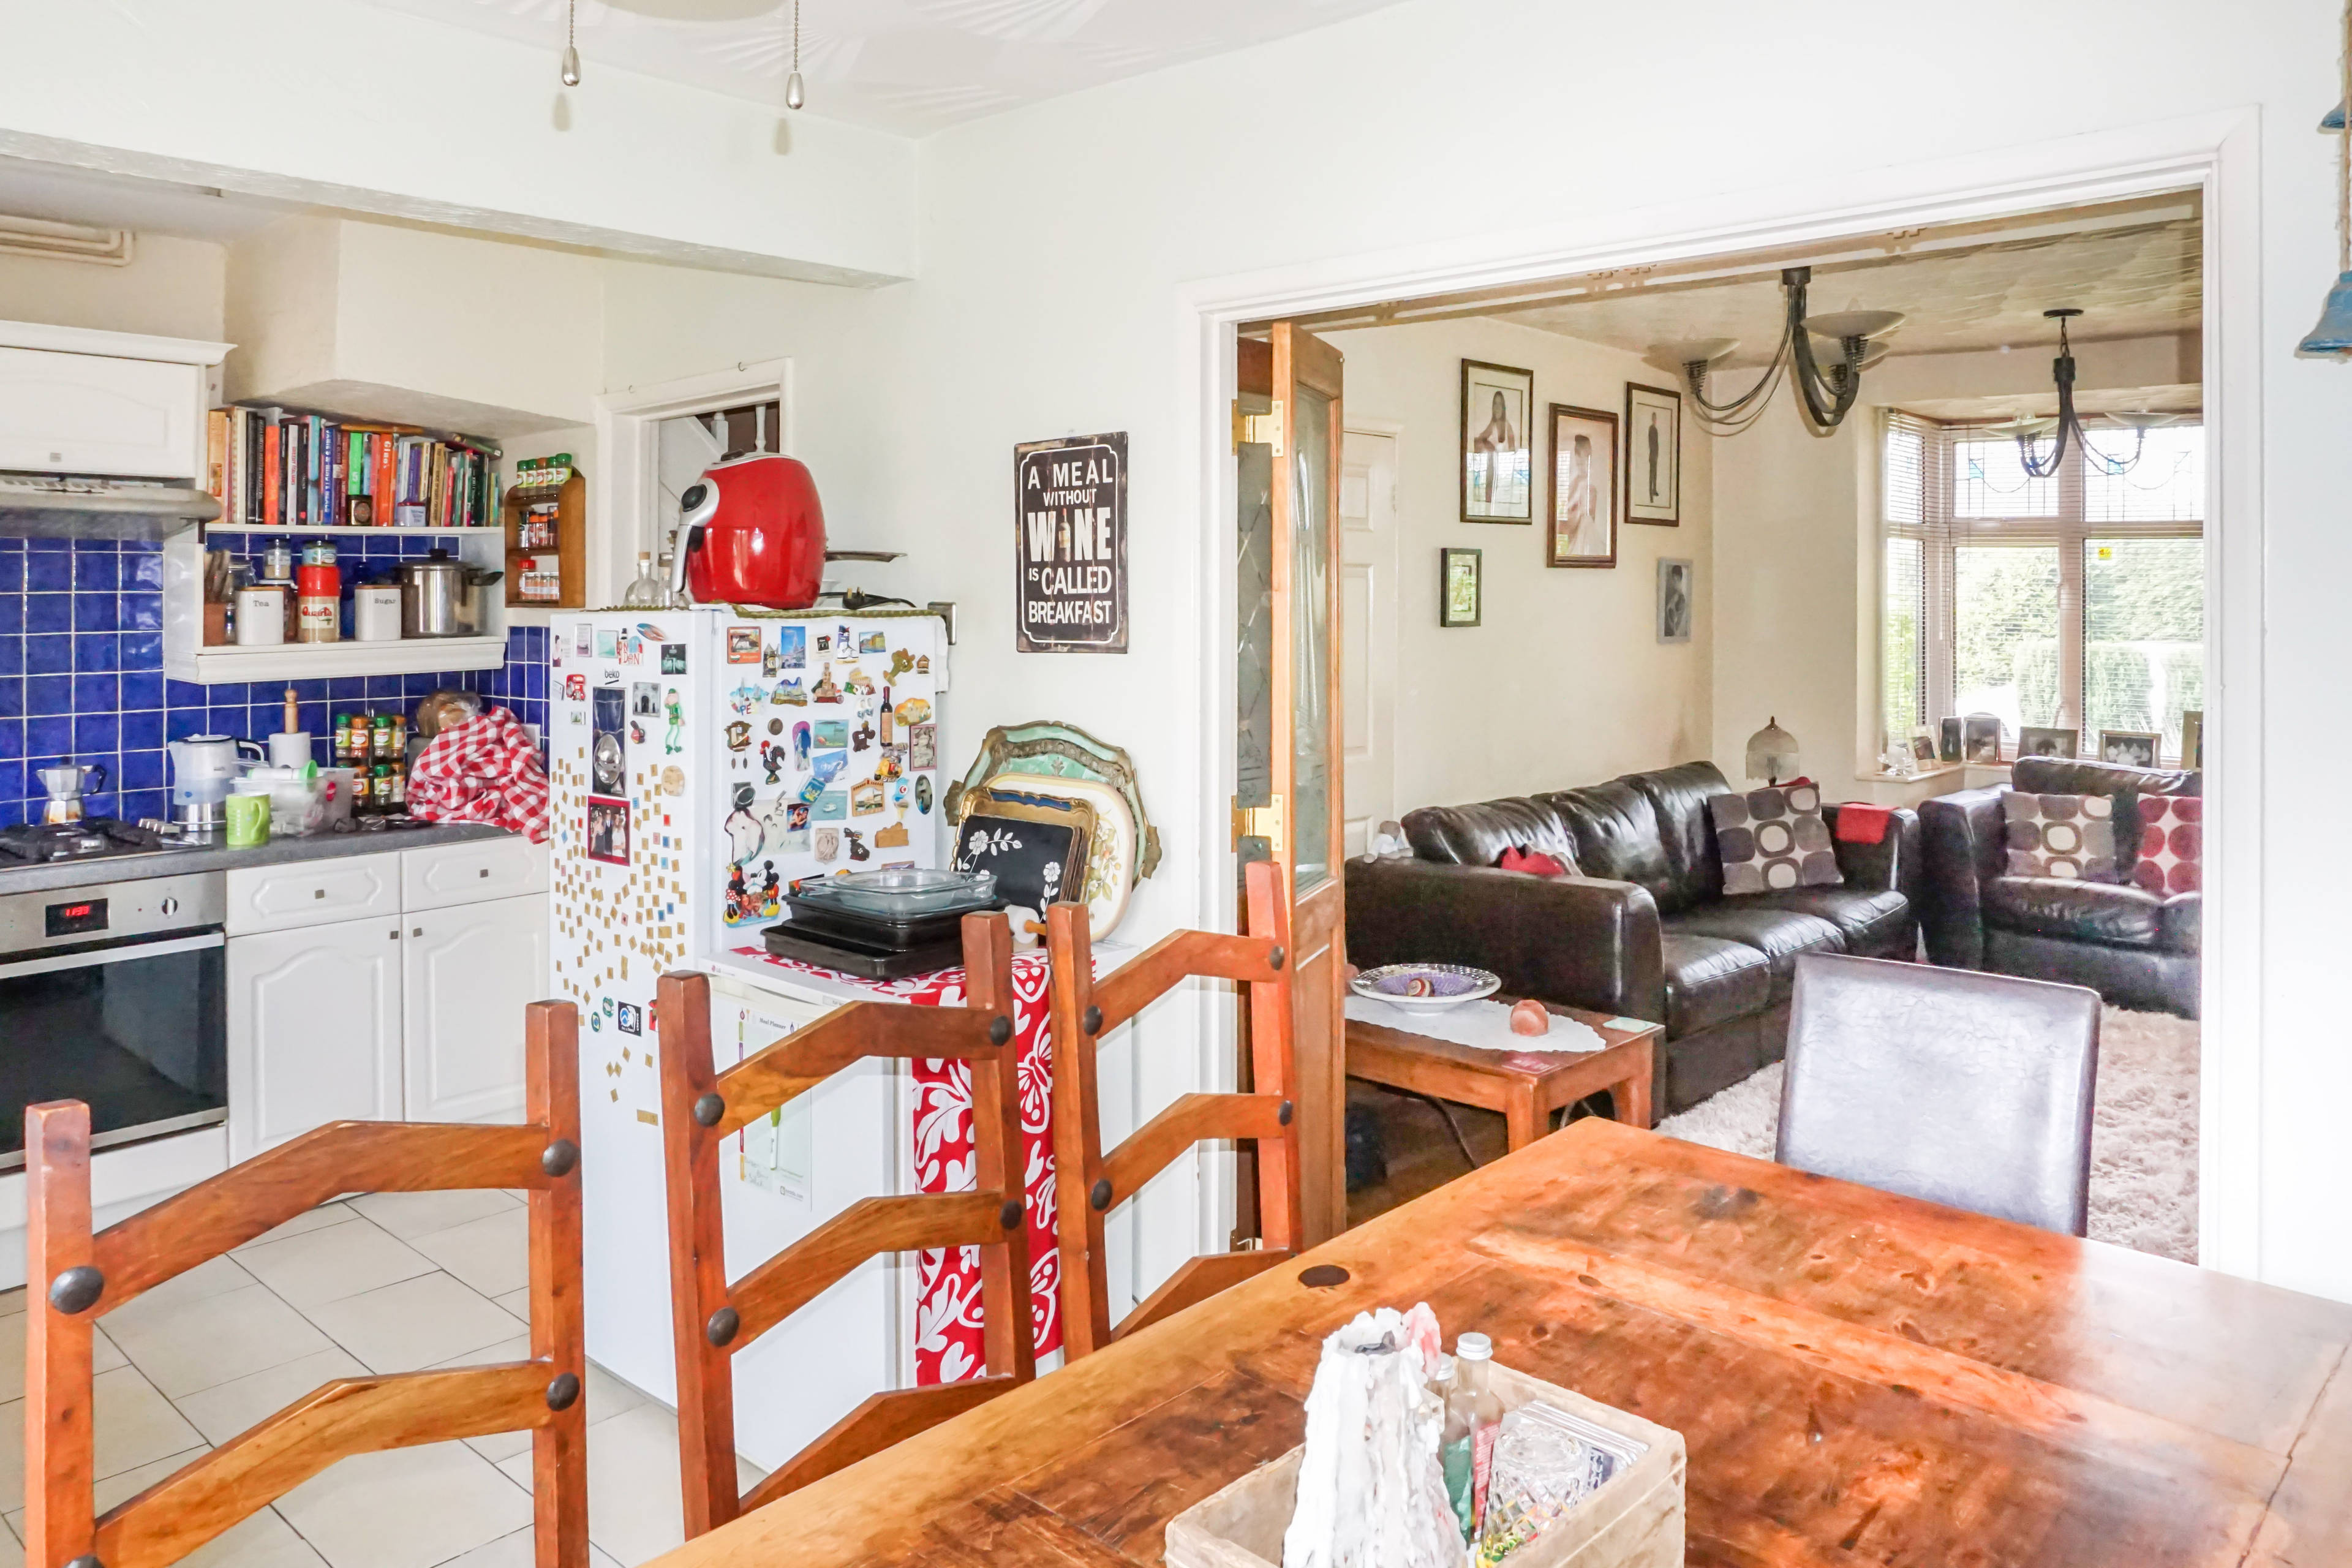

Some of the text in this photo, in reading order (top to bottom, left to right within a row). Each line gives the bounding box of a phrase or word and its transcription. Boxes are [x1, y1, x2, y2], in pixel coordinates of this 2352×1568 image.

[383, 440, 392, 469] Gino's
[1028, 459, 1113, 489] A MEAL
[1043, 488, 1097, 507] WITHOUT
[1029, 566, 1112, 595] IS CALLED
[1028, 601, 1112, 624] BREAKFAST
[605, 668, 620, 679] beko
[760, 1017, 786, 1030] Meal Planner
